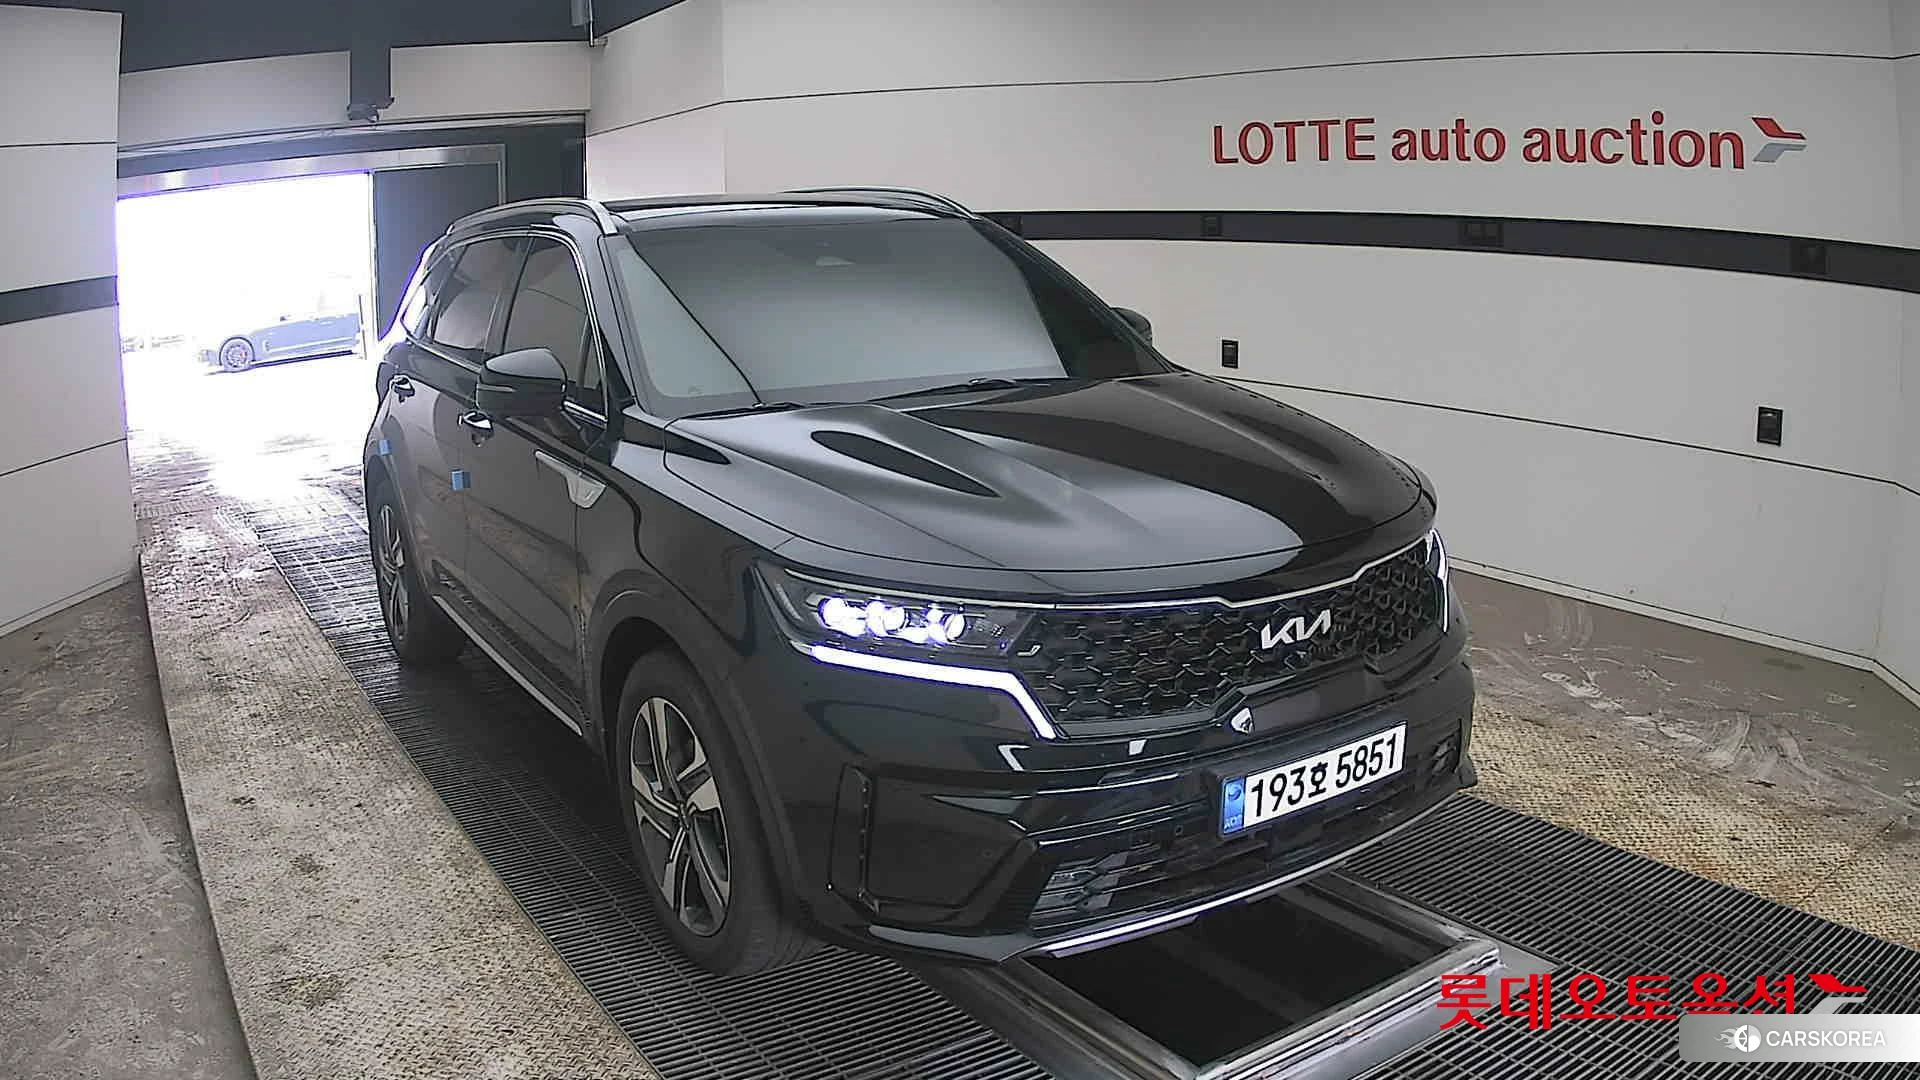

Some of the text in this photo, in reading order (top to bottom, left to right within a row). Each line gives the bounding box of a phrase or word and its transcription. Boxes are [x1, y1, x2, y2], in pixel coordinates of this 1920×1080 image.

[1213, 110, 1745, 170] LOTTE auto auction
[1260, 608, 1332, 650] KIA
[1251, 733, 1397, 818] 193호 5851
